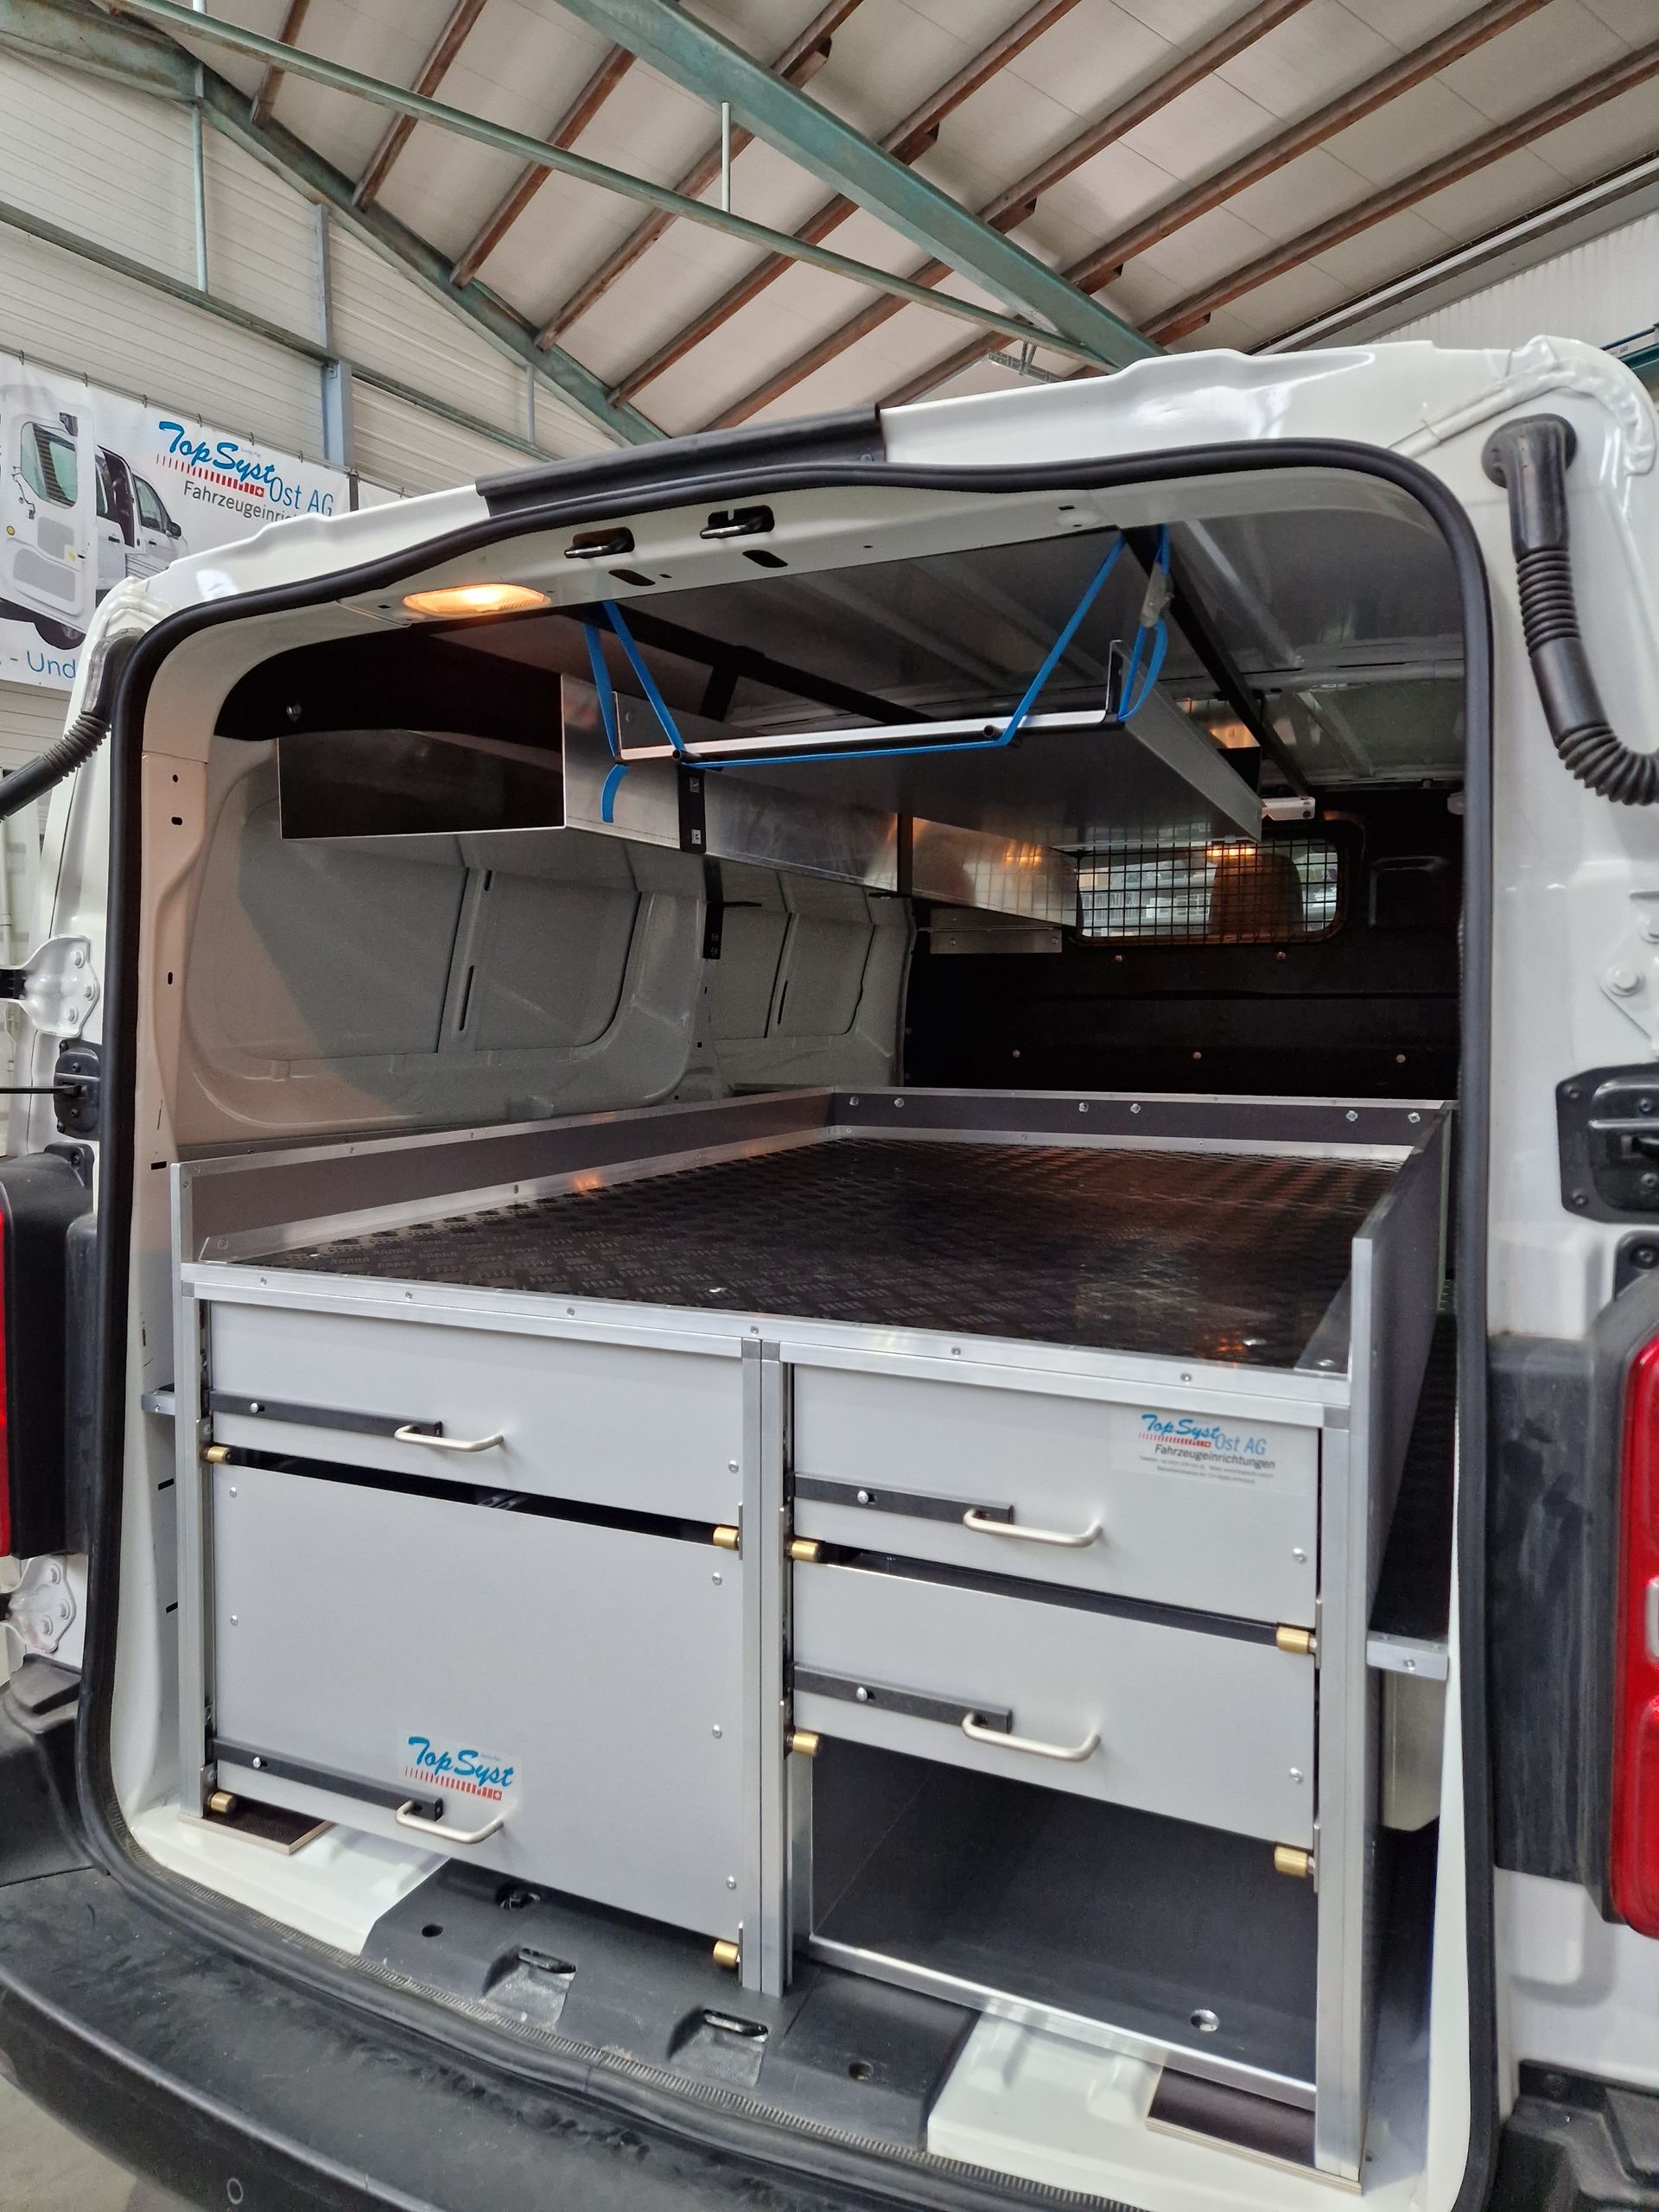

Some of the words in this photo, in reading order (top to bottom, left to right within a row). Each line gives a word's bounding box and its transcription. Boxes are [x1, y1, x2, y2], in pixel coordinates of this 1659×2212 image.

[159, 421, 275, 484] TopSyst
[270, 477, 302, 510] Ost
[307, 489, 334, 517] AG
[183, 480, 297, 521] Fahrzeugeinri
[1141, 1414, 1220, 1440] TopSyst
[1215, 1433, 1239, 1452] Ost
[1243, 1438, 1267, 1455] AG
[1154, 1443, 1275, 1469] Fahrzeugeinrichtungen
[408, 1736, 515, 1788] TopSyst
